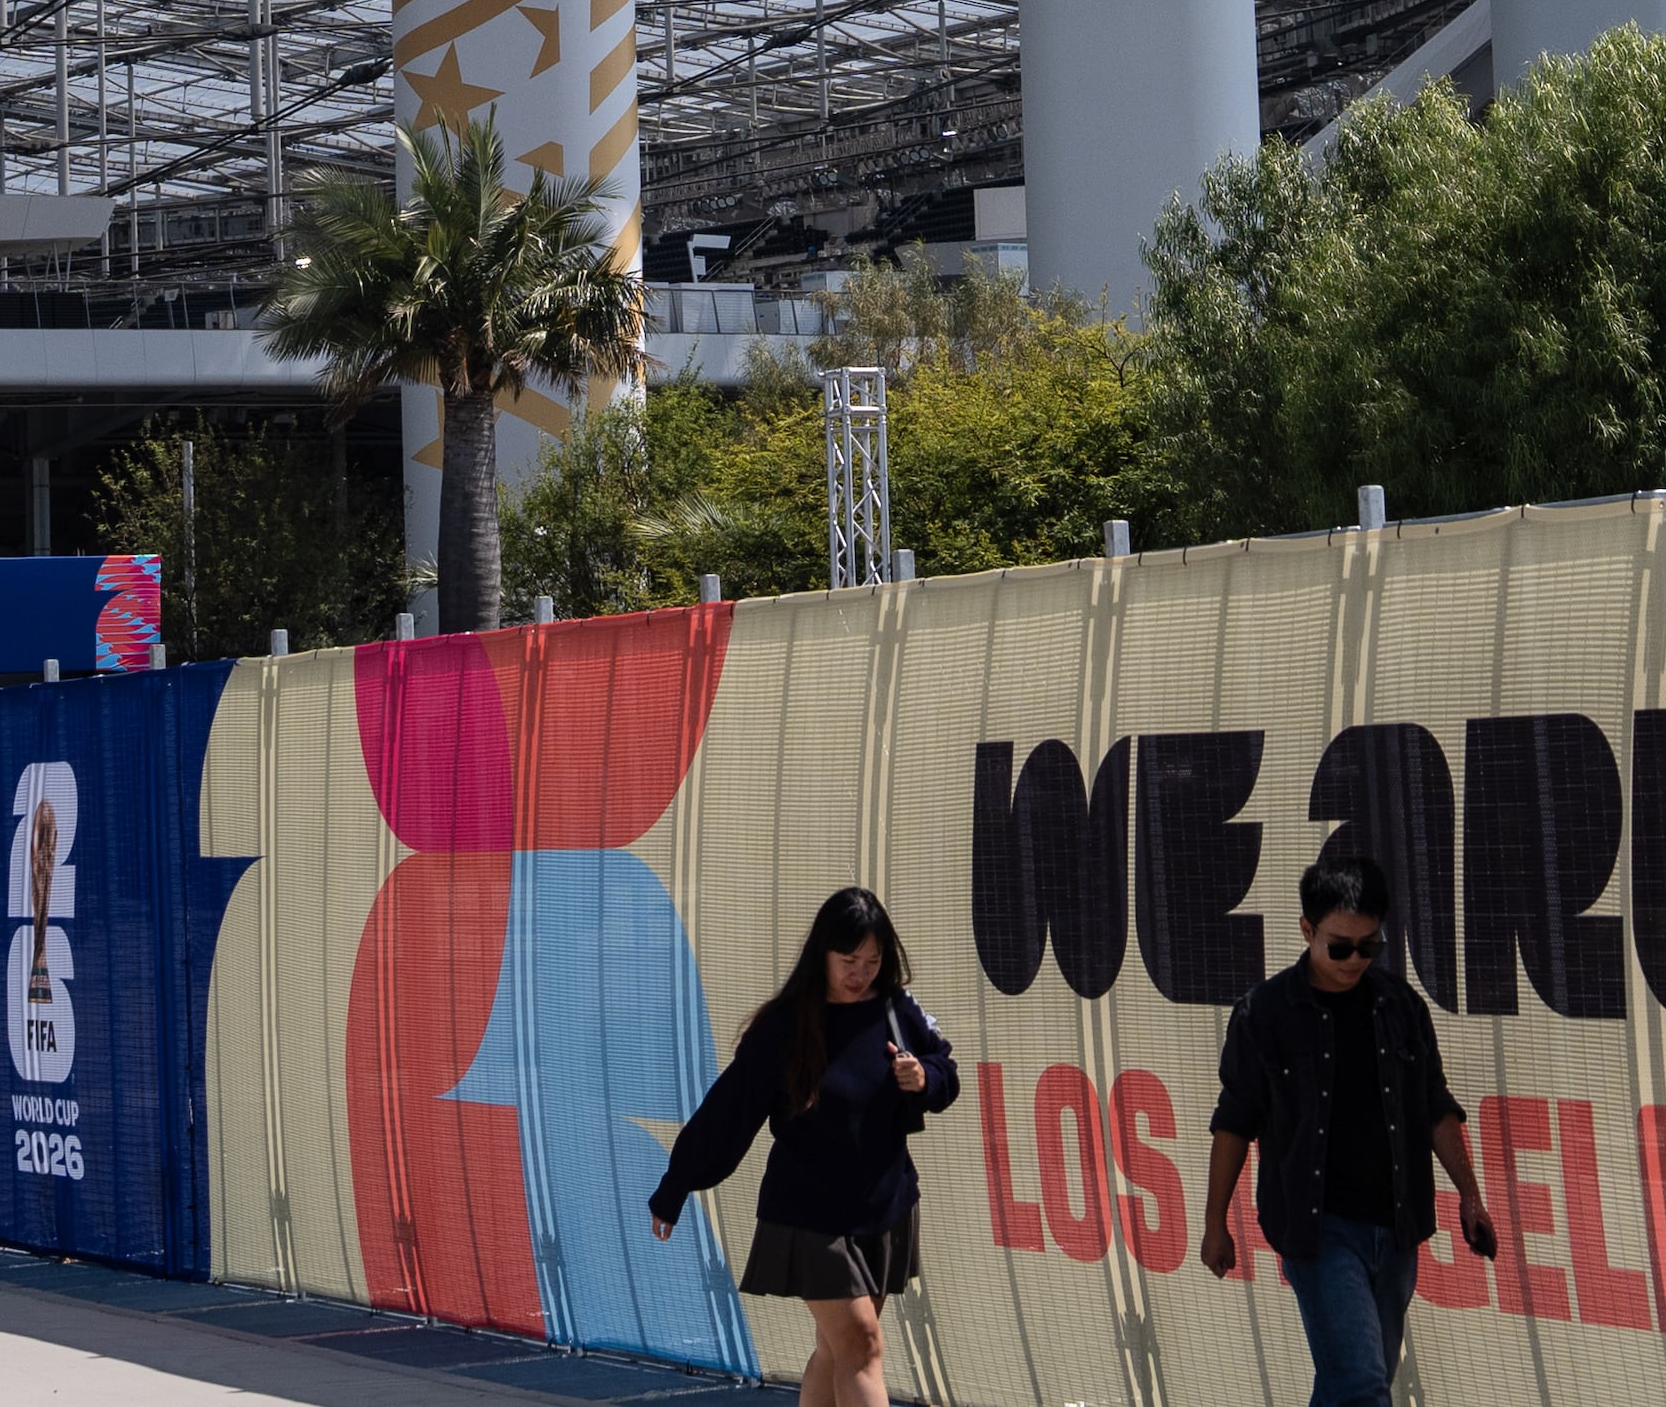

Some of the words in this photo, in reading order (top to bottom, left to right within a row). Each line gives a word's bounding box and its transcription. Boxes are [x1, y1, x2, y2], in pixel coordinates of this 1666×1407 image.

[972, 729, 1265, 1005] WE
[27, 1019, 57, 1052] FIFA
[12, 1095, 54, 1123] WORLD
[55, 1099, 79, 1127] CUP
[15, 1129, 85, 1180] 2026
[976, 1061, 1187, 1274] LOS
